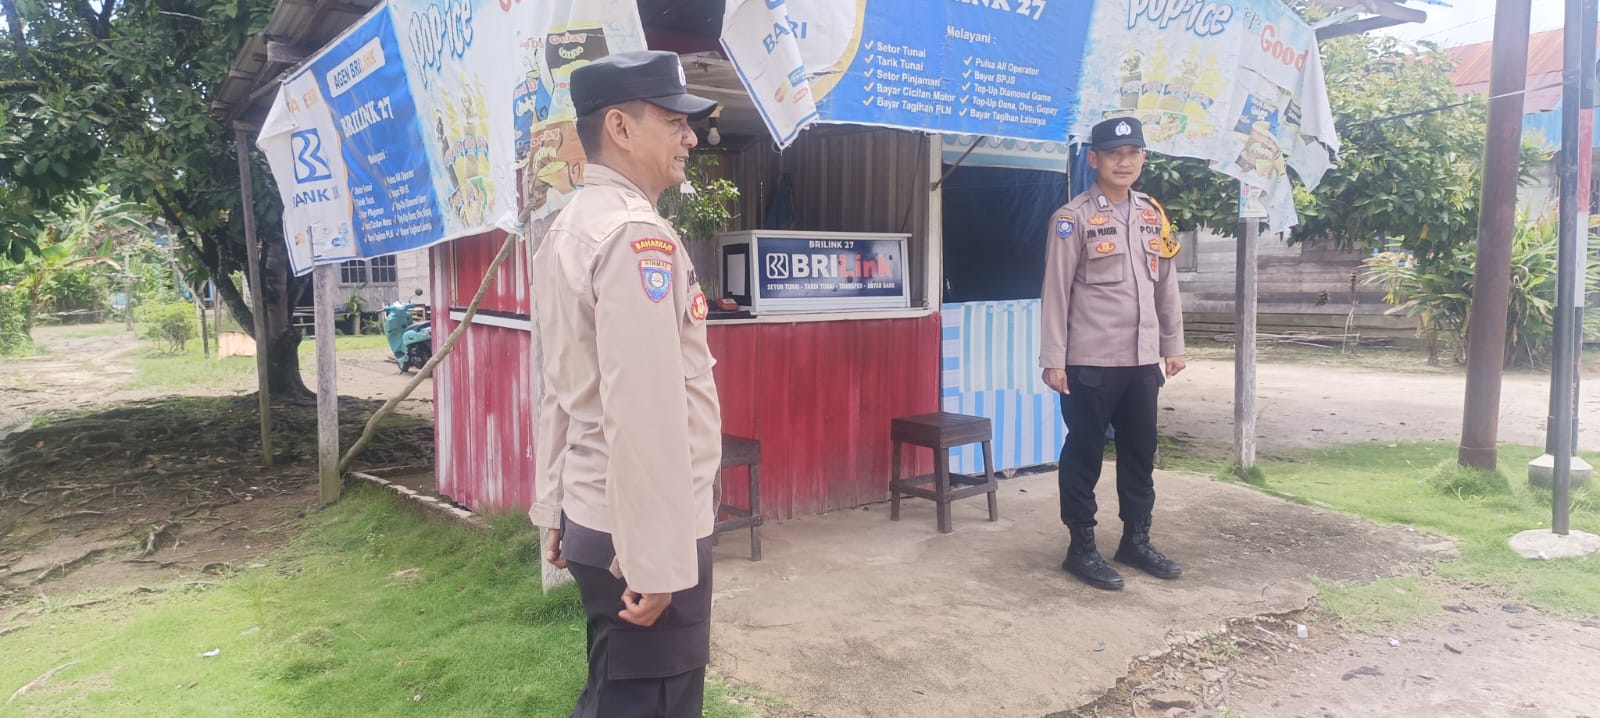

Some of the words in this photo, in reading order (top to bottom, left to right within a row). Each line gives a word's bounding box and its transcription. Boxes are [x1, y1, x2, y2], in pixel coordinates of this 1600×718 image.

[947, 26, 990, 44] Melayani
[876, 42, 900, 53] Setor
[902, 46, 926, 57] Tunai
[1260, 24, 1308, 72] Good
[877, 56, 898, 67] Tarik
[900, 59, 924, 71] Tunai
[975, 58, 995, 70] Pulsa
[997, 62, 1006, 70] All
[1008, 63, 1039, 76] Operator
[334, 68, 352, 90] AGEN
[876, 70, 899, 81] Setor
[902, 73, 940, 87] Pinjaman
[974, 71, 995, 83] Bayar
[996, 74, 1015, 85] BPJS
[876, 83, 900, 96] Bayar
[903, 87, 931, 98] Cicilan
[933, 91, 956, 102] Motor
[974, 83, 998, 96] Top-Up
[1000, 88, 1030, 100] Diamond
[1032, 92, 1051, 102] Game
[877, 97, 899, 109] Bayar
[902, 100, 933, 112] Tagihan
[936, 104, 951, 114] PLN
[973, 96, 997, 108] Top-Up
[1036, 105, 1058, 116] Gopay
[341, 100, 381, 138] BRILINK
[378, 96, 394, 119] 27
[970, 109, 990, 120] Bayar
[993, 112, 1018, 123] Tagihan
[292, 188, 331, 208] ANK
[809, 241, 842, 249] BRILINK
[792, 254, 893, 278] BRILink
